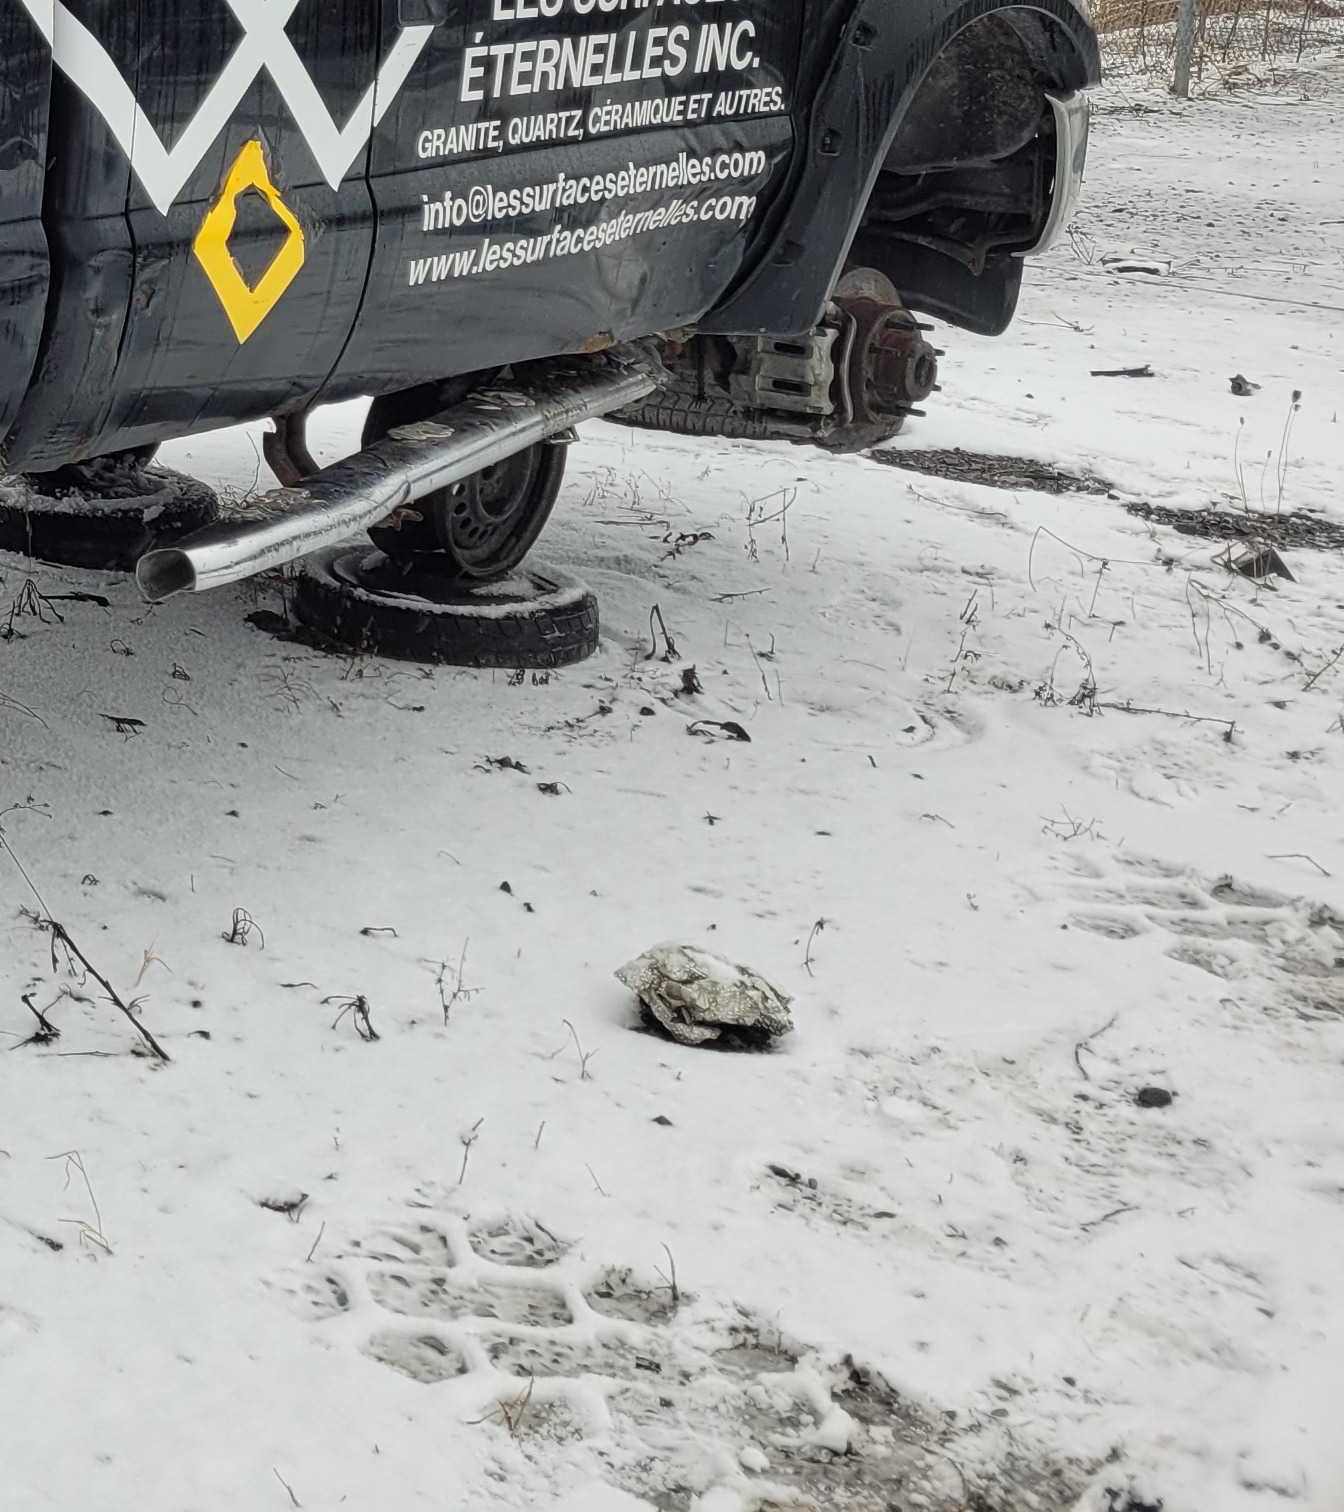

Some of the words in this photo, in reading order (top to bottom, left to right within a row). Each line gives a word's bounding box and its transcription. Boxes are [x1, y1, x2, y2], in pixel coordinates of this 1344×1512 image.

[459, 25, 689, 103] ÉTERNELLES
[694, 20, 761, 74] INC.
[417, 120, 504, 159] GRANITE,
[507, 111, 584, 145] QUARTZ,
[588, 96, 686, 134] CÉRAMIQUE
[686, 91, 711, 120] ET
[712, 86, 786, 117] AUTRES.
[422, 149, 766, 232] info@lessurfaceseternelles.com
[408, 194, 757, 287] www.lessurfaceseternelles.com
